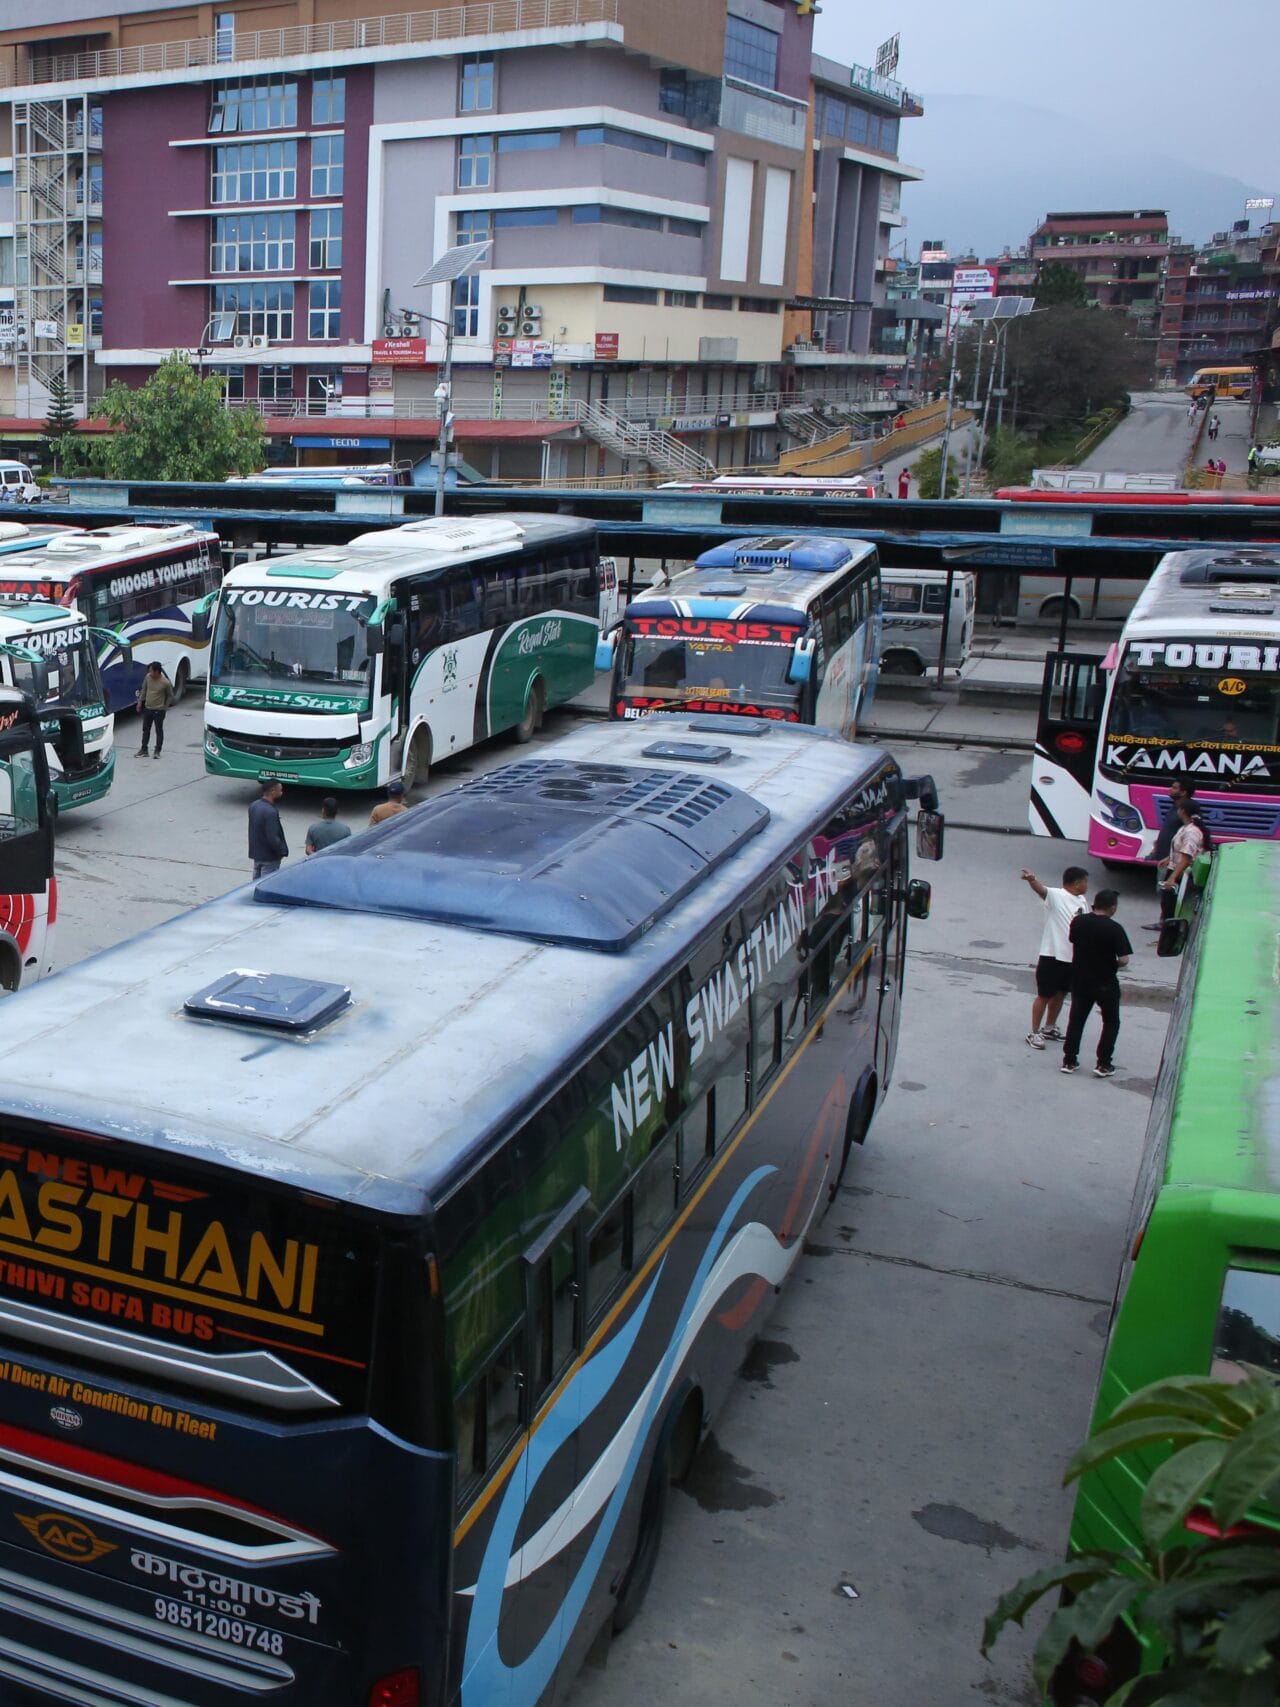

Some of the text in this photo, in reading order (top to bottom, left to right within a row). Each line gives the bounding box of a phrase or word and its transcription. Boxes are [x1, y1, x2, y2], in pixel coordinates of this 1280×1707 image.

[330, 438, 360, 447] TECNO
[110, 555, 210, 598] CHOOSE YOUR BEST
[226, 590, 368, 611] TOURIST
[632, 618, 801, 644] TOURIST
[688, 643, 734, 652] YATRA
[1130, 642, 1280, 671] TOURI
[1221, 680, 1244, 692] A/C
[80, 706, 105, 720] Star
[291, 696, 346, 710] Star
[631, 697, 761, 715] SAEENA
[1106, 745, 1271, 776] KAMANA
[611, 1021, 676, 1152] NEW
[685, 880, 807, 1065] SWASTHANI
[27, 1148, 148, 1199] NEW
[72, 1280, 145, 1324] SOFA
[151, 1302, 216, 1342] BUS
[13, 1361, 45, 1391] Duct
[48, 1371, 70, 1398] Air
[72, 1385, 148, 1421] Condition
[150, 1406, 172, 1427] On
[176, 1410, 217, 1441] Fleet
[44, 1524, 89, 1551] AC
[183, 1589, 247, 1618] 11:00
[155, 1598, 283, 1656] 9851209748
